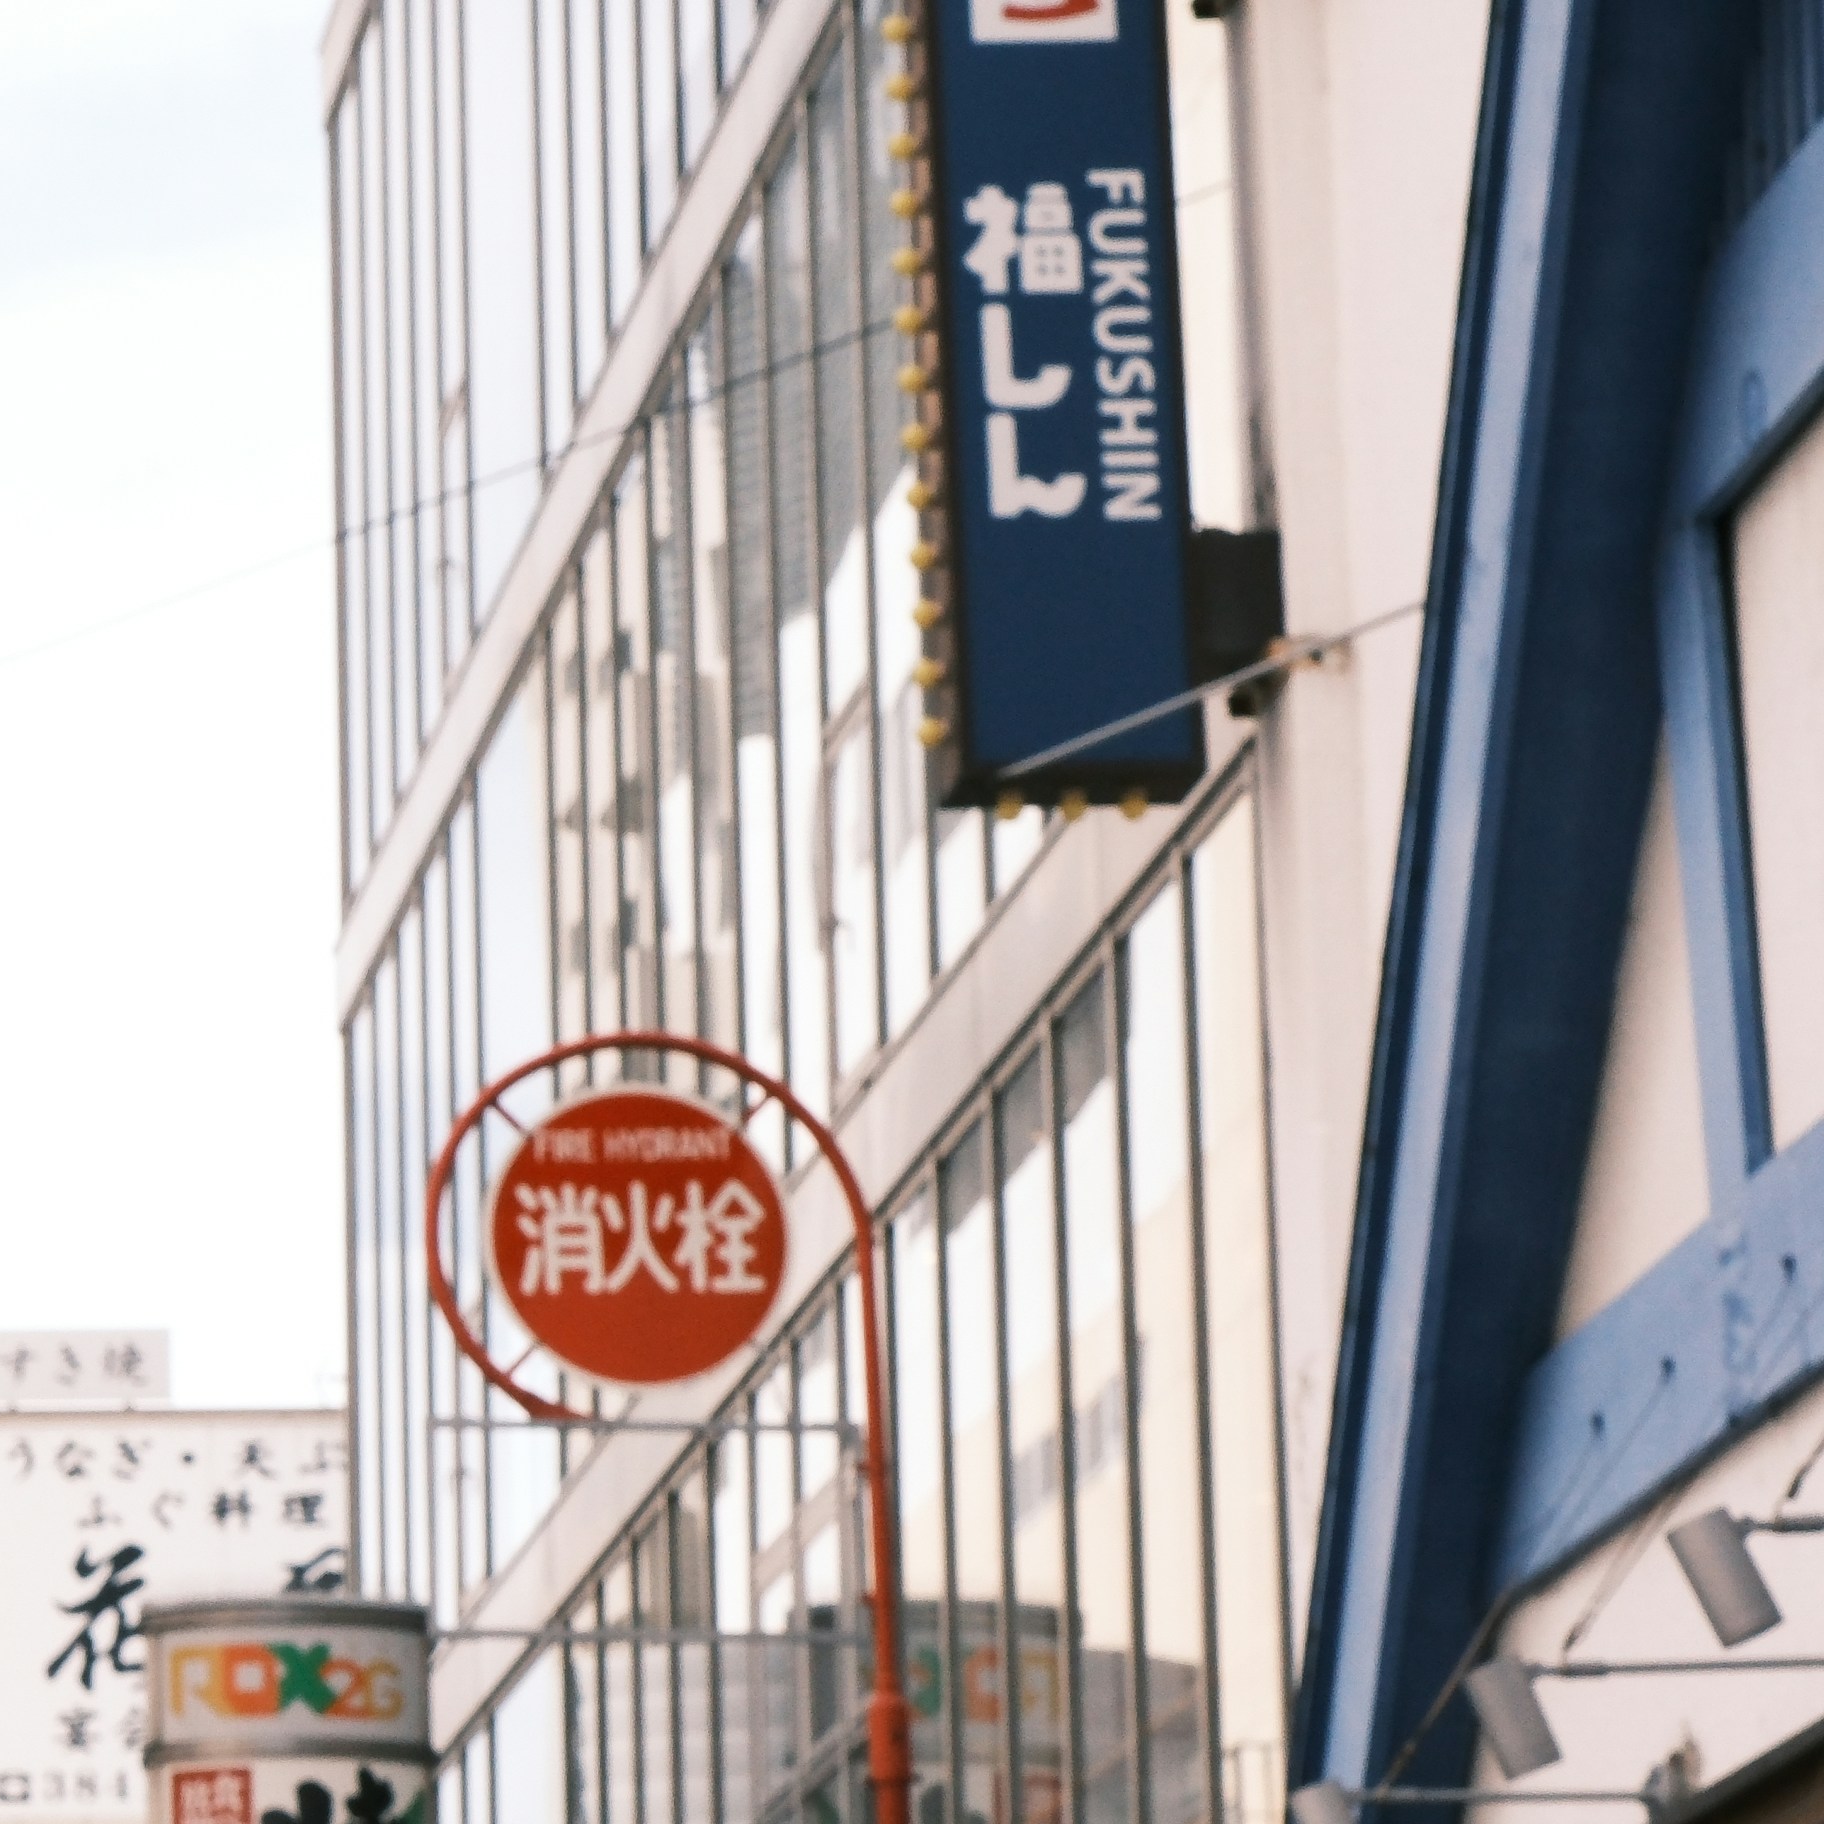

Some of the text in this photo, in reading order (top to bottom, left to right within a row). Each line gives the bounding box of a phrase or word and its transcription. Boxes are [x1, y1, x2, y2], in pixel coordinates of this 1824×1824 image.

[963, 182, 1088, 522] 福しん
[1088, 167, 1163, 522] FUKUSHIN
[513, 1179, 768, 1294] 消火栓
[532, 1126, 731, 1163] FIRE HYDRANT
